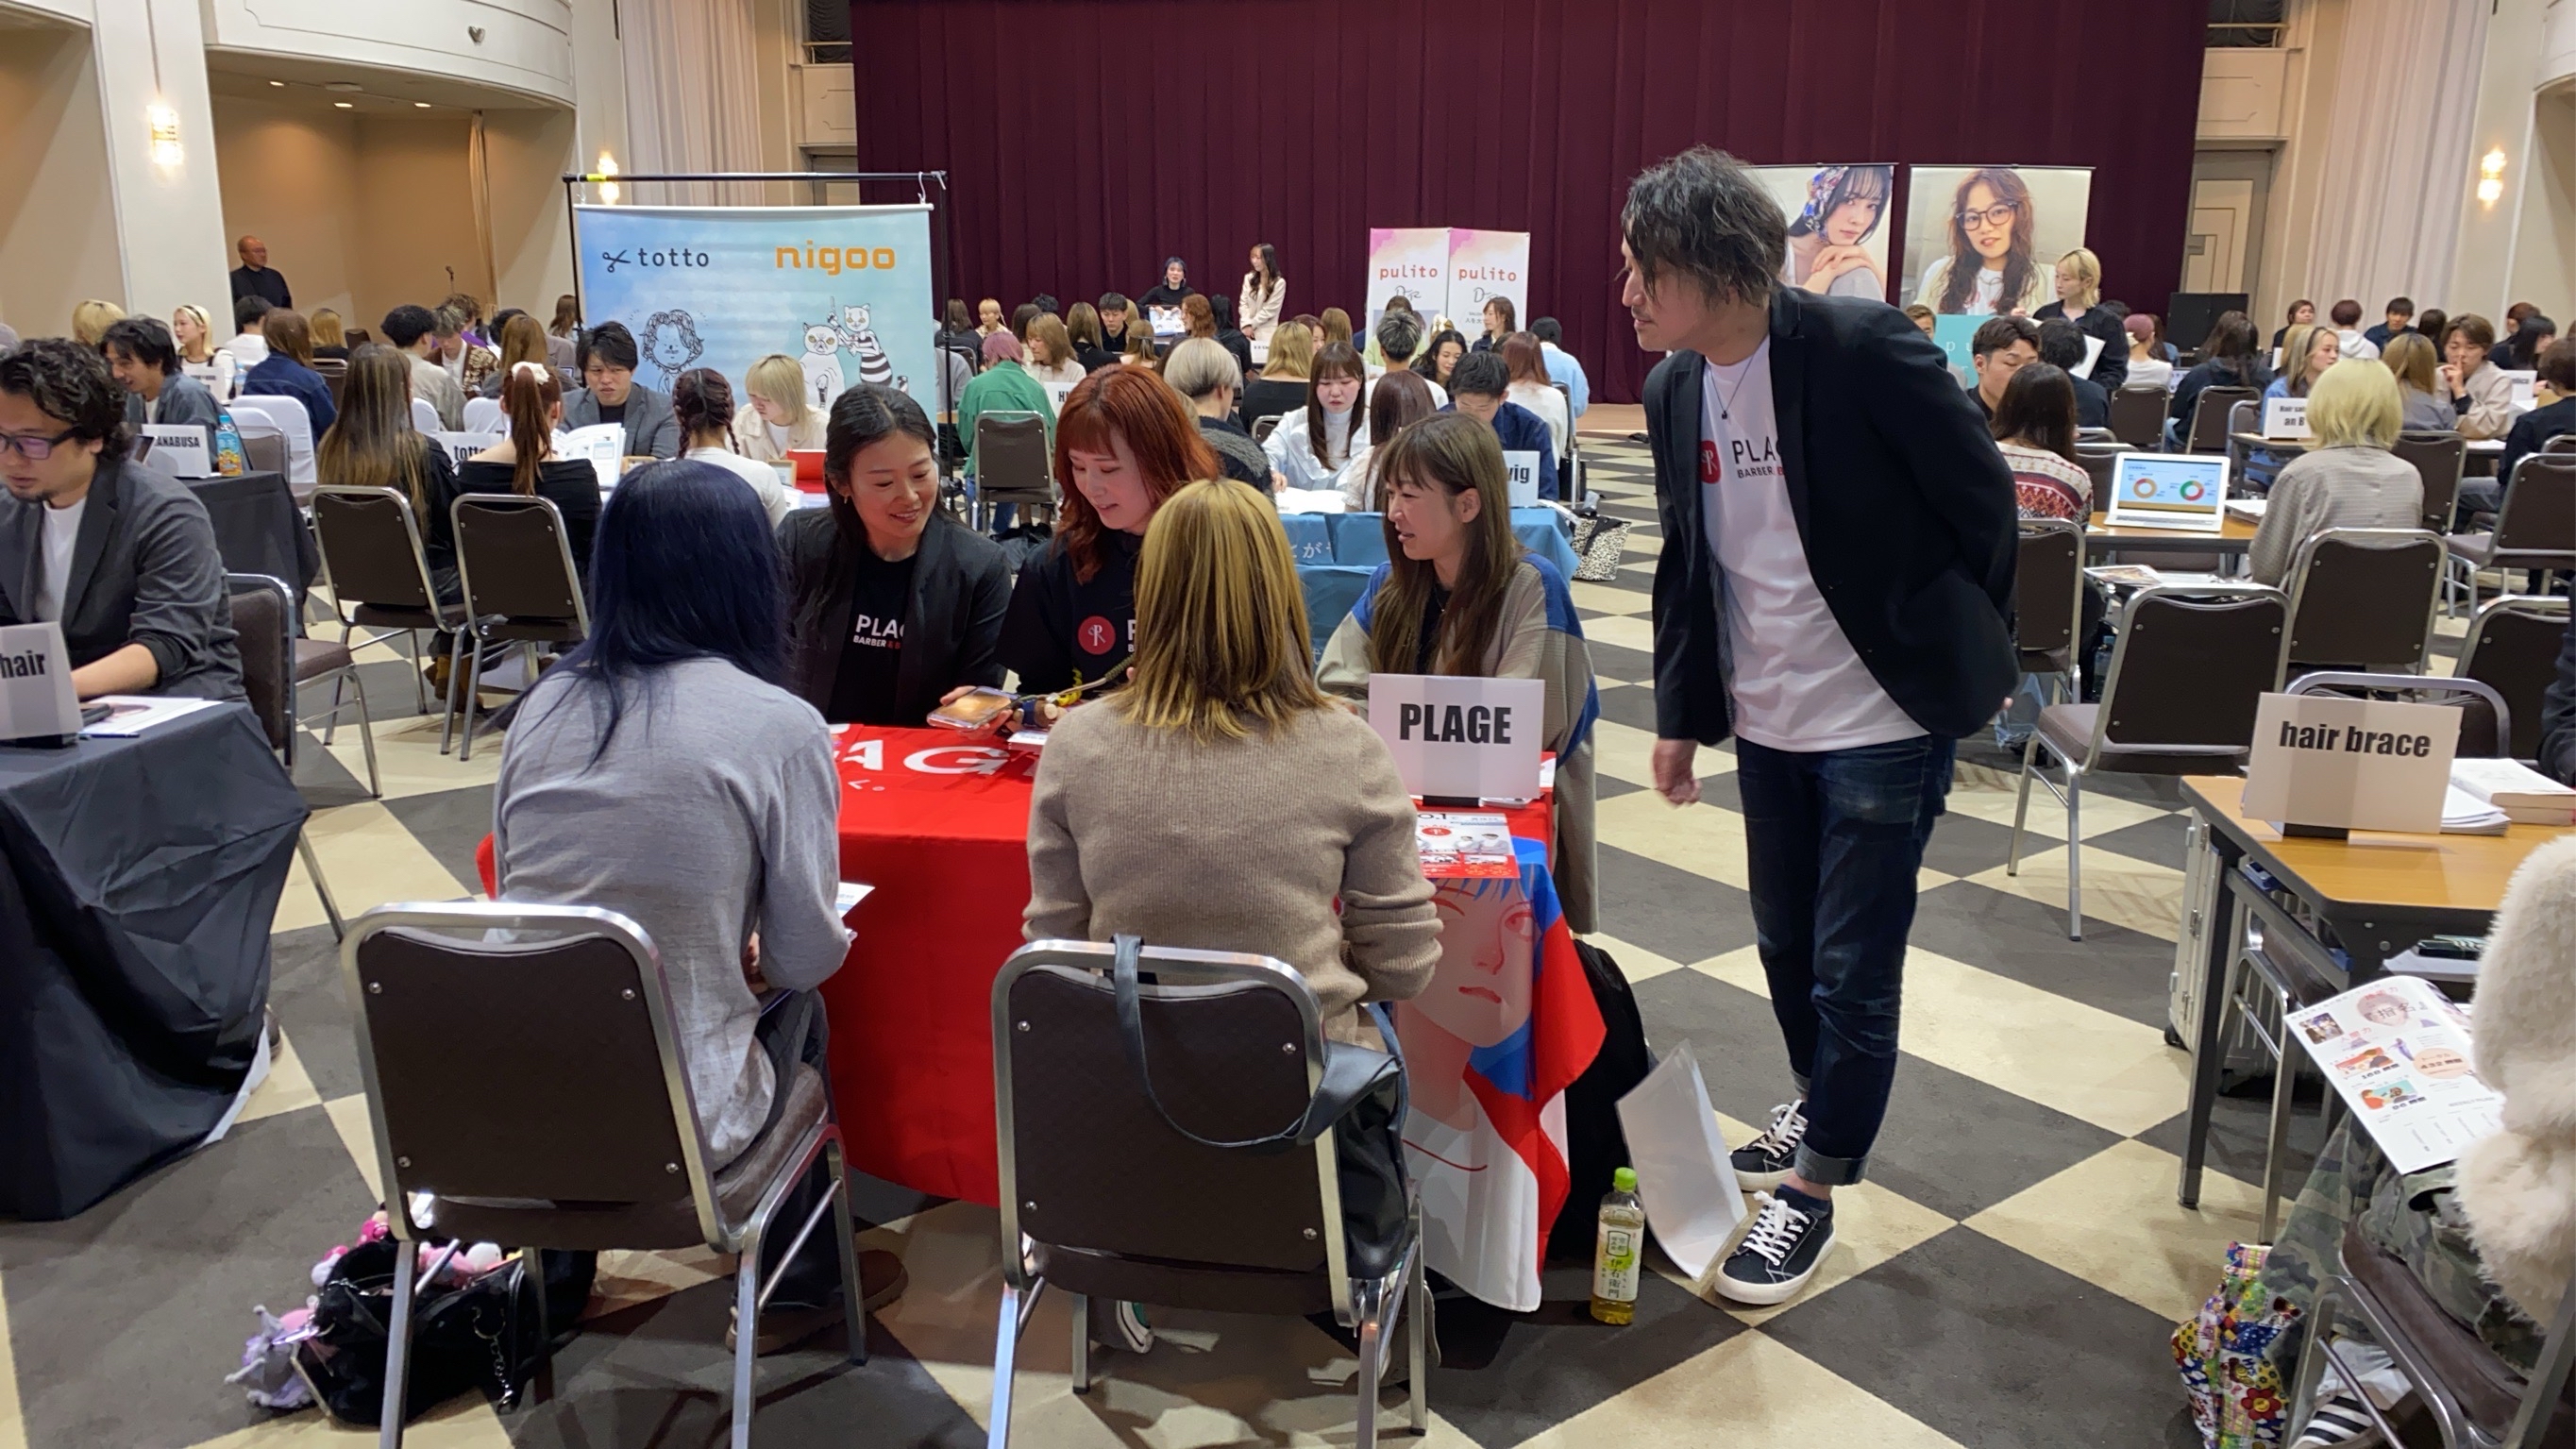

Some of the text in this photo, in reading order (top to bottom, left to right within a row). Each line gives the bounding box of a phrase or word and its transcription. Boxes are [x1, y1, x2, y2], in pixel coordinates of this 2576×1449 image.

[638, 247, 709, 267] totto
[775, 240, 895, 276] nigoo
[1379, 264, 1438, 280] pulito
[1458, 266, 1517, 281] pulito
[1738, 466, 1774, 479] BARBER
[853, 635, 886, 648] BARBER
[1400, 703, 1511, 744] PLAGE
[2279, 721, 2432, 758] hair brace
